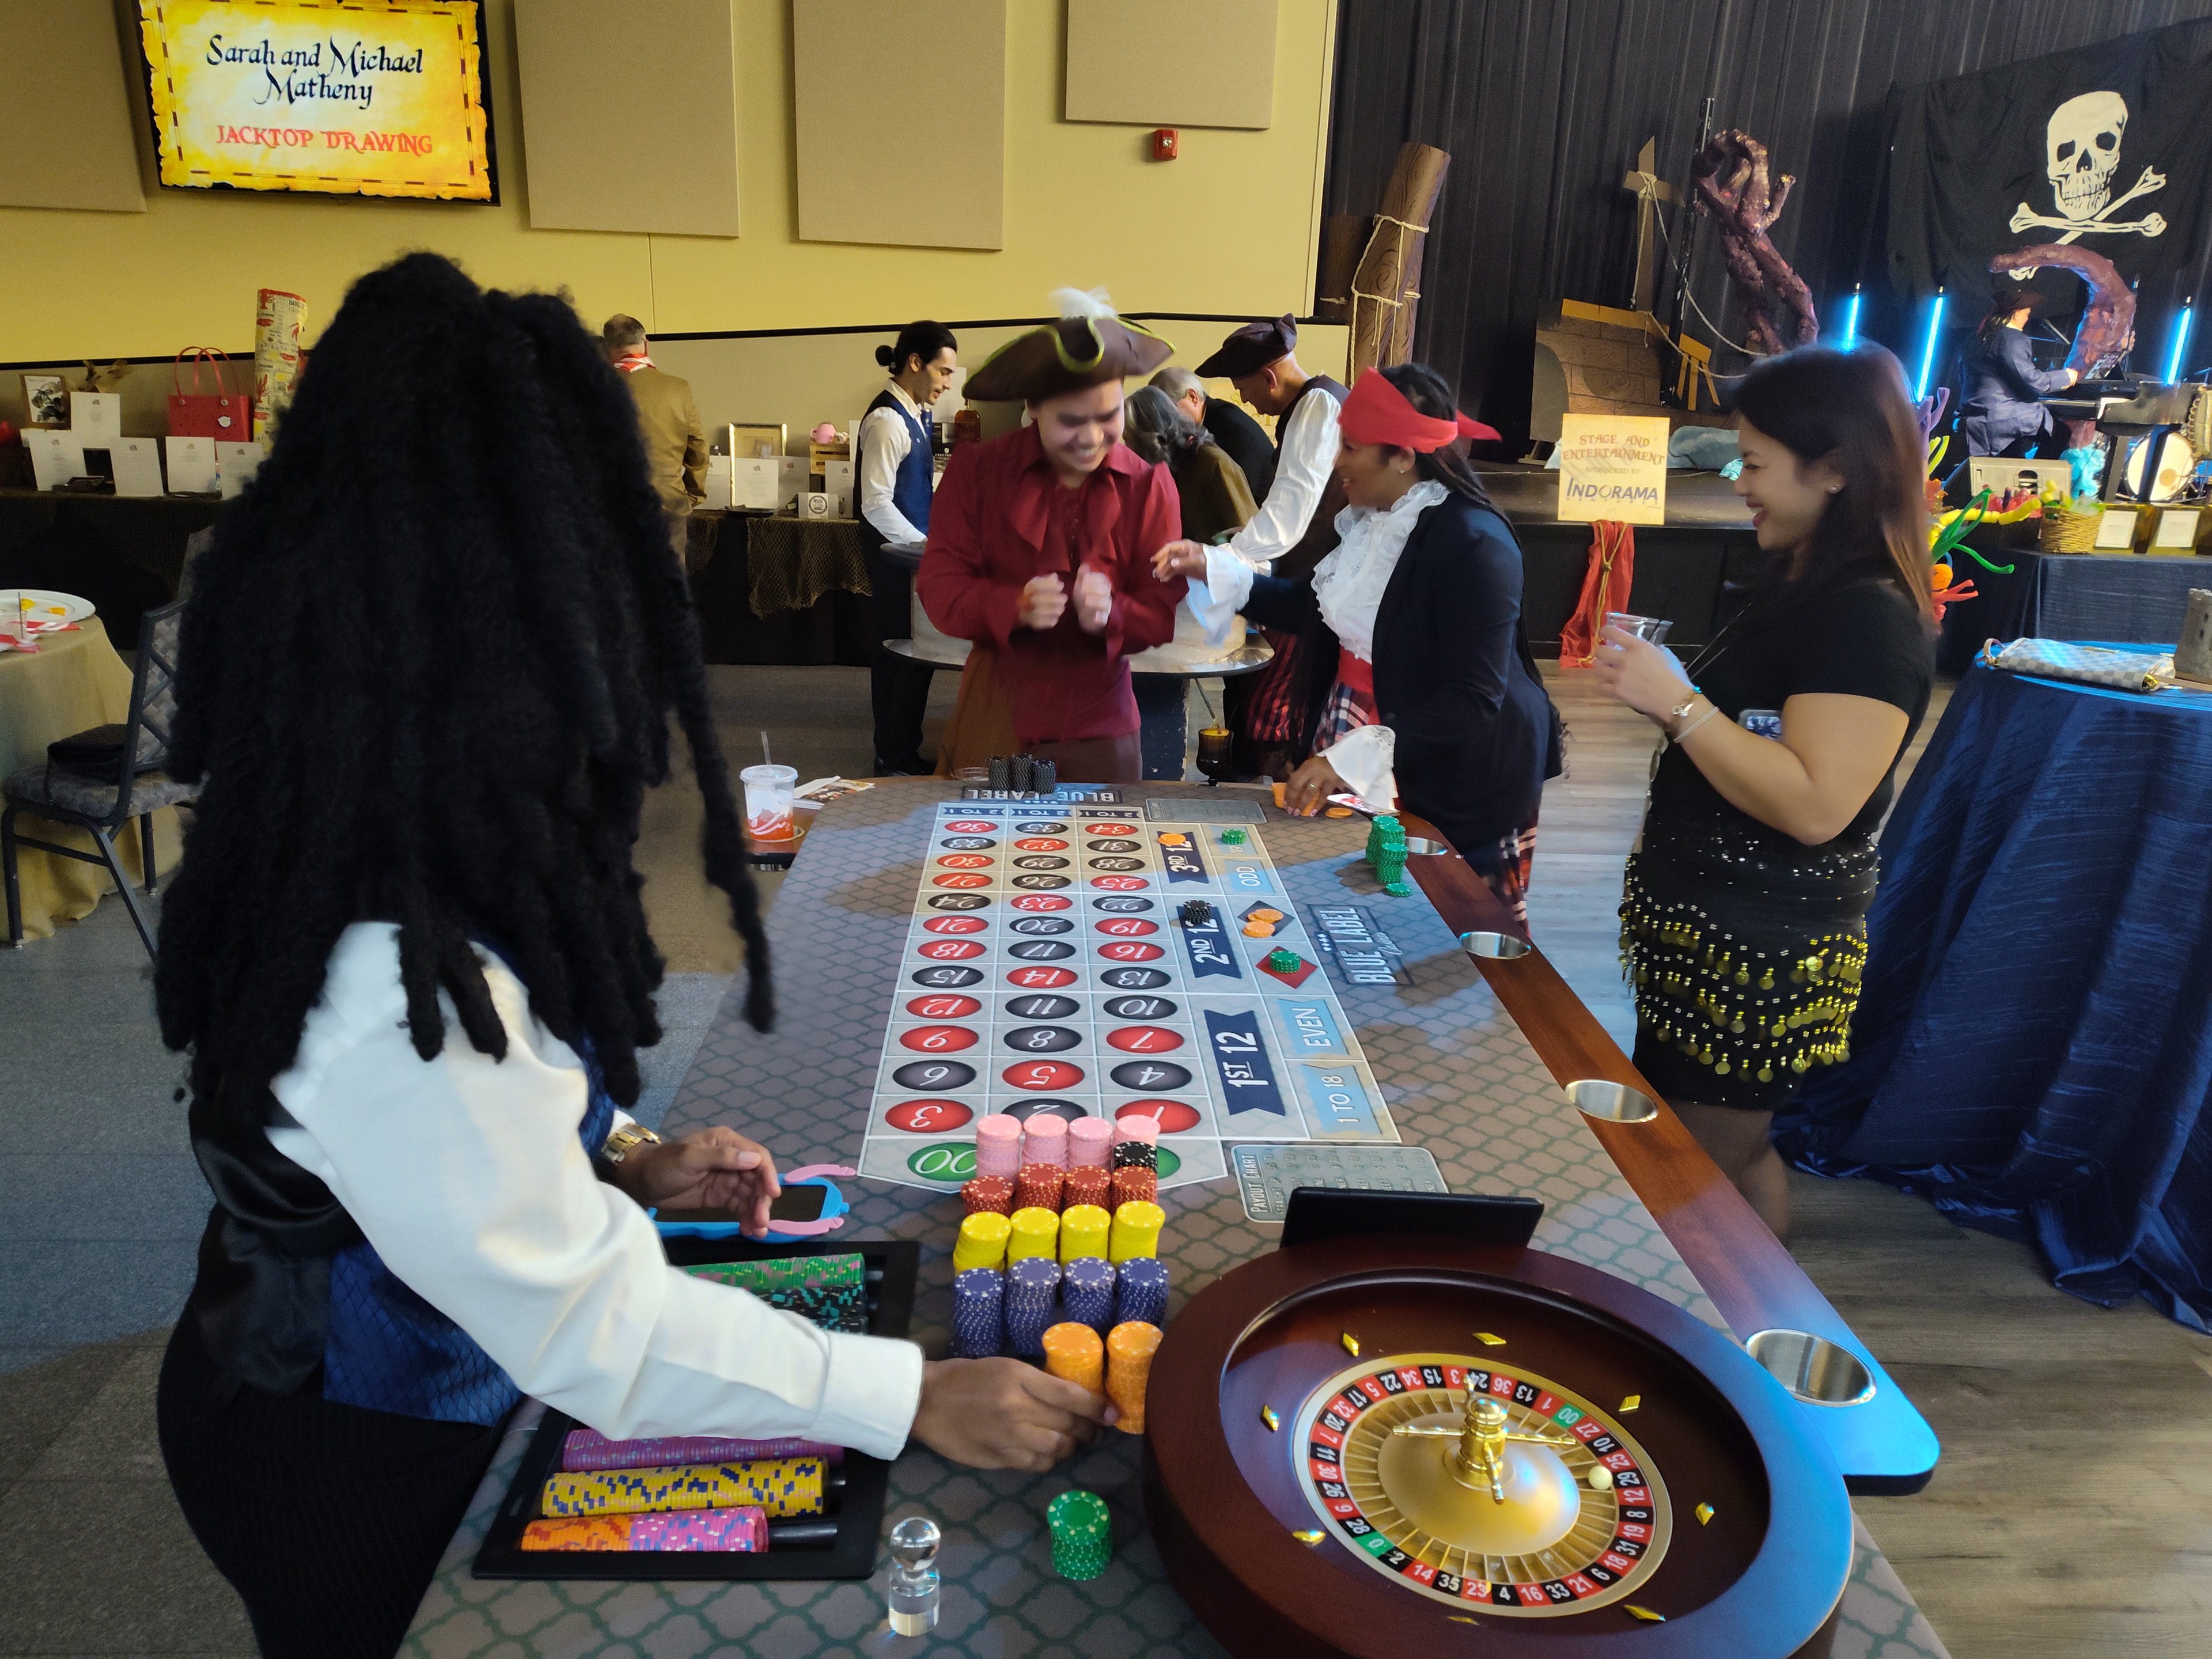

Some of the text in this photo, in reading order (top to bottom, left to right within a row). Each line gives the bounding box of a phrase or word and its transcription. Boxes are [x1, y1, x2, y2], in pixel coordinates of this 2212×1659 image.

[206, 34, 423, 78] Sarah and Michael
[253, 64, 373, 109] Matheny
[216, 125, 432, 157] JACKTOP DRAWING
[1580, 434, 1650, 448] STAGE AND
[1562, 448, 1665, 465] ENTERTAINMENT
[1585, 467, 1629, 475] SPONSORED
[1566, 477, 1658, 501] INDORAMA
[1057, 791, 1115, 802] BLUE
[953, 822, 989, 832] 36
[1022, 823, 1061, 833] 35
[1093, 824, 1130, 835] 34
[949, 838, 988, 849] 33
[1022, 839, 1060, 850] 32
[1099, 840, 1129, 851] 31
[944, 856, 987, 867] 30
[1020, 857, 1060, 868] 29
[1095, 858, 1135, 869] 28
[1167, 855, 1200, 873] 3RD
[940, 875, 984, 887] 27
[1021, 876, 1062, 888] 26
[1096, 878, 1142, 890] 25
[1235, 866, 1262, 887] ODD
[935, 896, 982, 908] 24
[1018, 897, 1063, 910] 23
[1101, 897, 1143, 911] 22
[934, 918, 975, 932] 21
[1016, 919, 1065, 933] 20
[1109, 921, 1142, 934] 19
[931, 943, 970, 957] 18
[1022, 944, 1057, 957] 17
[1114, 945, 1147, 959] 16
[1190, 938, 1230, 965] 2ND
[1319, 907, 1397, 983] BLUE LABEL
[925, 969, 969, 984] 15
[1022, 970, 1060, 985] 14
[1117, 971, 1152, 986] 13
[922, 998, 963, 1016] 12
[1026, 998, 1057, 1015] 11
[1118, 999, 1159, 1016] 10
[1291, 1007, 1332, 1047] EVEN
[1028, 1030, 1056, 1048] 8
[1130, 1031, 1154, 1049] 7
[1215, 1032, 1269, 1088] 1ST 12
[1023, 1066, 1056, 1085] 5
[1138, 1066, 1166, 1086] 4
[1321, 1075, 1346, 1088] 18
[1328, 1093, 1354, 1112] TO
[910, 1105, 943, 1128] 3
[1241, 1154, 1268, 1213] PAYOUT CHART
[1380, 1374, 1402, 1391] 22
[1402, 1370, 1422, 1387] 34
[1423, 1369, 1442, 1384] 15
[1449, 1369, 1460, 1384] 3
[1366, 1382, 1380, 1397] 5
[1493, 1377, 1512, 1394] 36
[1348, 1389, 1368, 1408] 17
[1516, 1385, 1533, 1402] 13
[1333, 1400, 1355, 1418] 32
[1541, 1397, 1552, 1410] 1
[1324, 1412, 1345, 1431] 20
[1558, 1407, 1580, 1425] 00
[1575, 1422, 1600, 1438] 27
[1320, 1432, 1338, 1444] 7
[1593, 1437, 1615, 1452] 10
[1317, 1446, 1336, 1462] 11
[1606, 1453, 1630, 1469] 25
[1317, 1464, 1338, 1479] 30
[1616, 1471, 1640, 1486] 29
[1323, 1482, 1345, 1498] 26
[1623, 1489, 1645, 1503] 12
[1626, 1510, 1647, 1518] 8
[1345, 1518, 1370, 1535] 28
[1622, 1524, 1645, 1537] 19
[1615, 1540, 1639, 1556] 31
[1389, 1550, 1406, 1565] 2
[1603, 1554, 1628, 1570] 18
[1413, 1564, 1434, 1580] 14
[1438, 1574, 1460, 1592] 35
[1545, 1582, 1570, 1599] 33
[1568, 1575, 1593, 1593] 21
[1499, 1586, 1510, 1601] 4
[1521, 1586, 1543, 1601] 16
